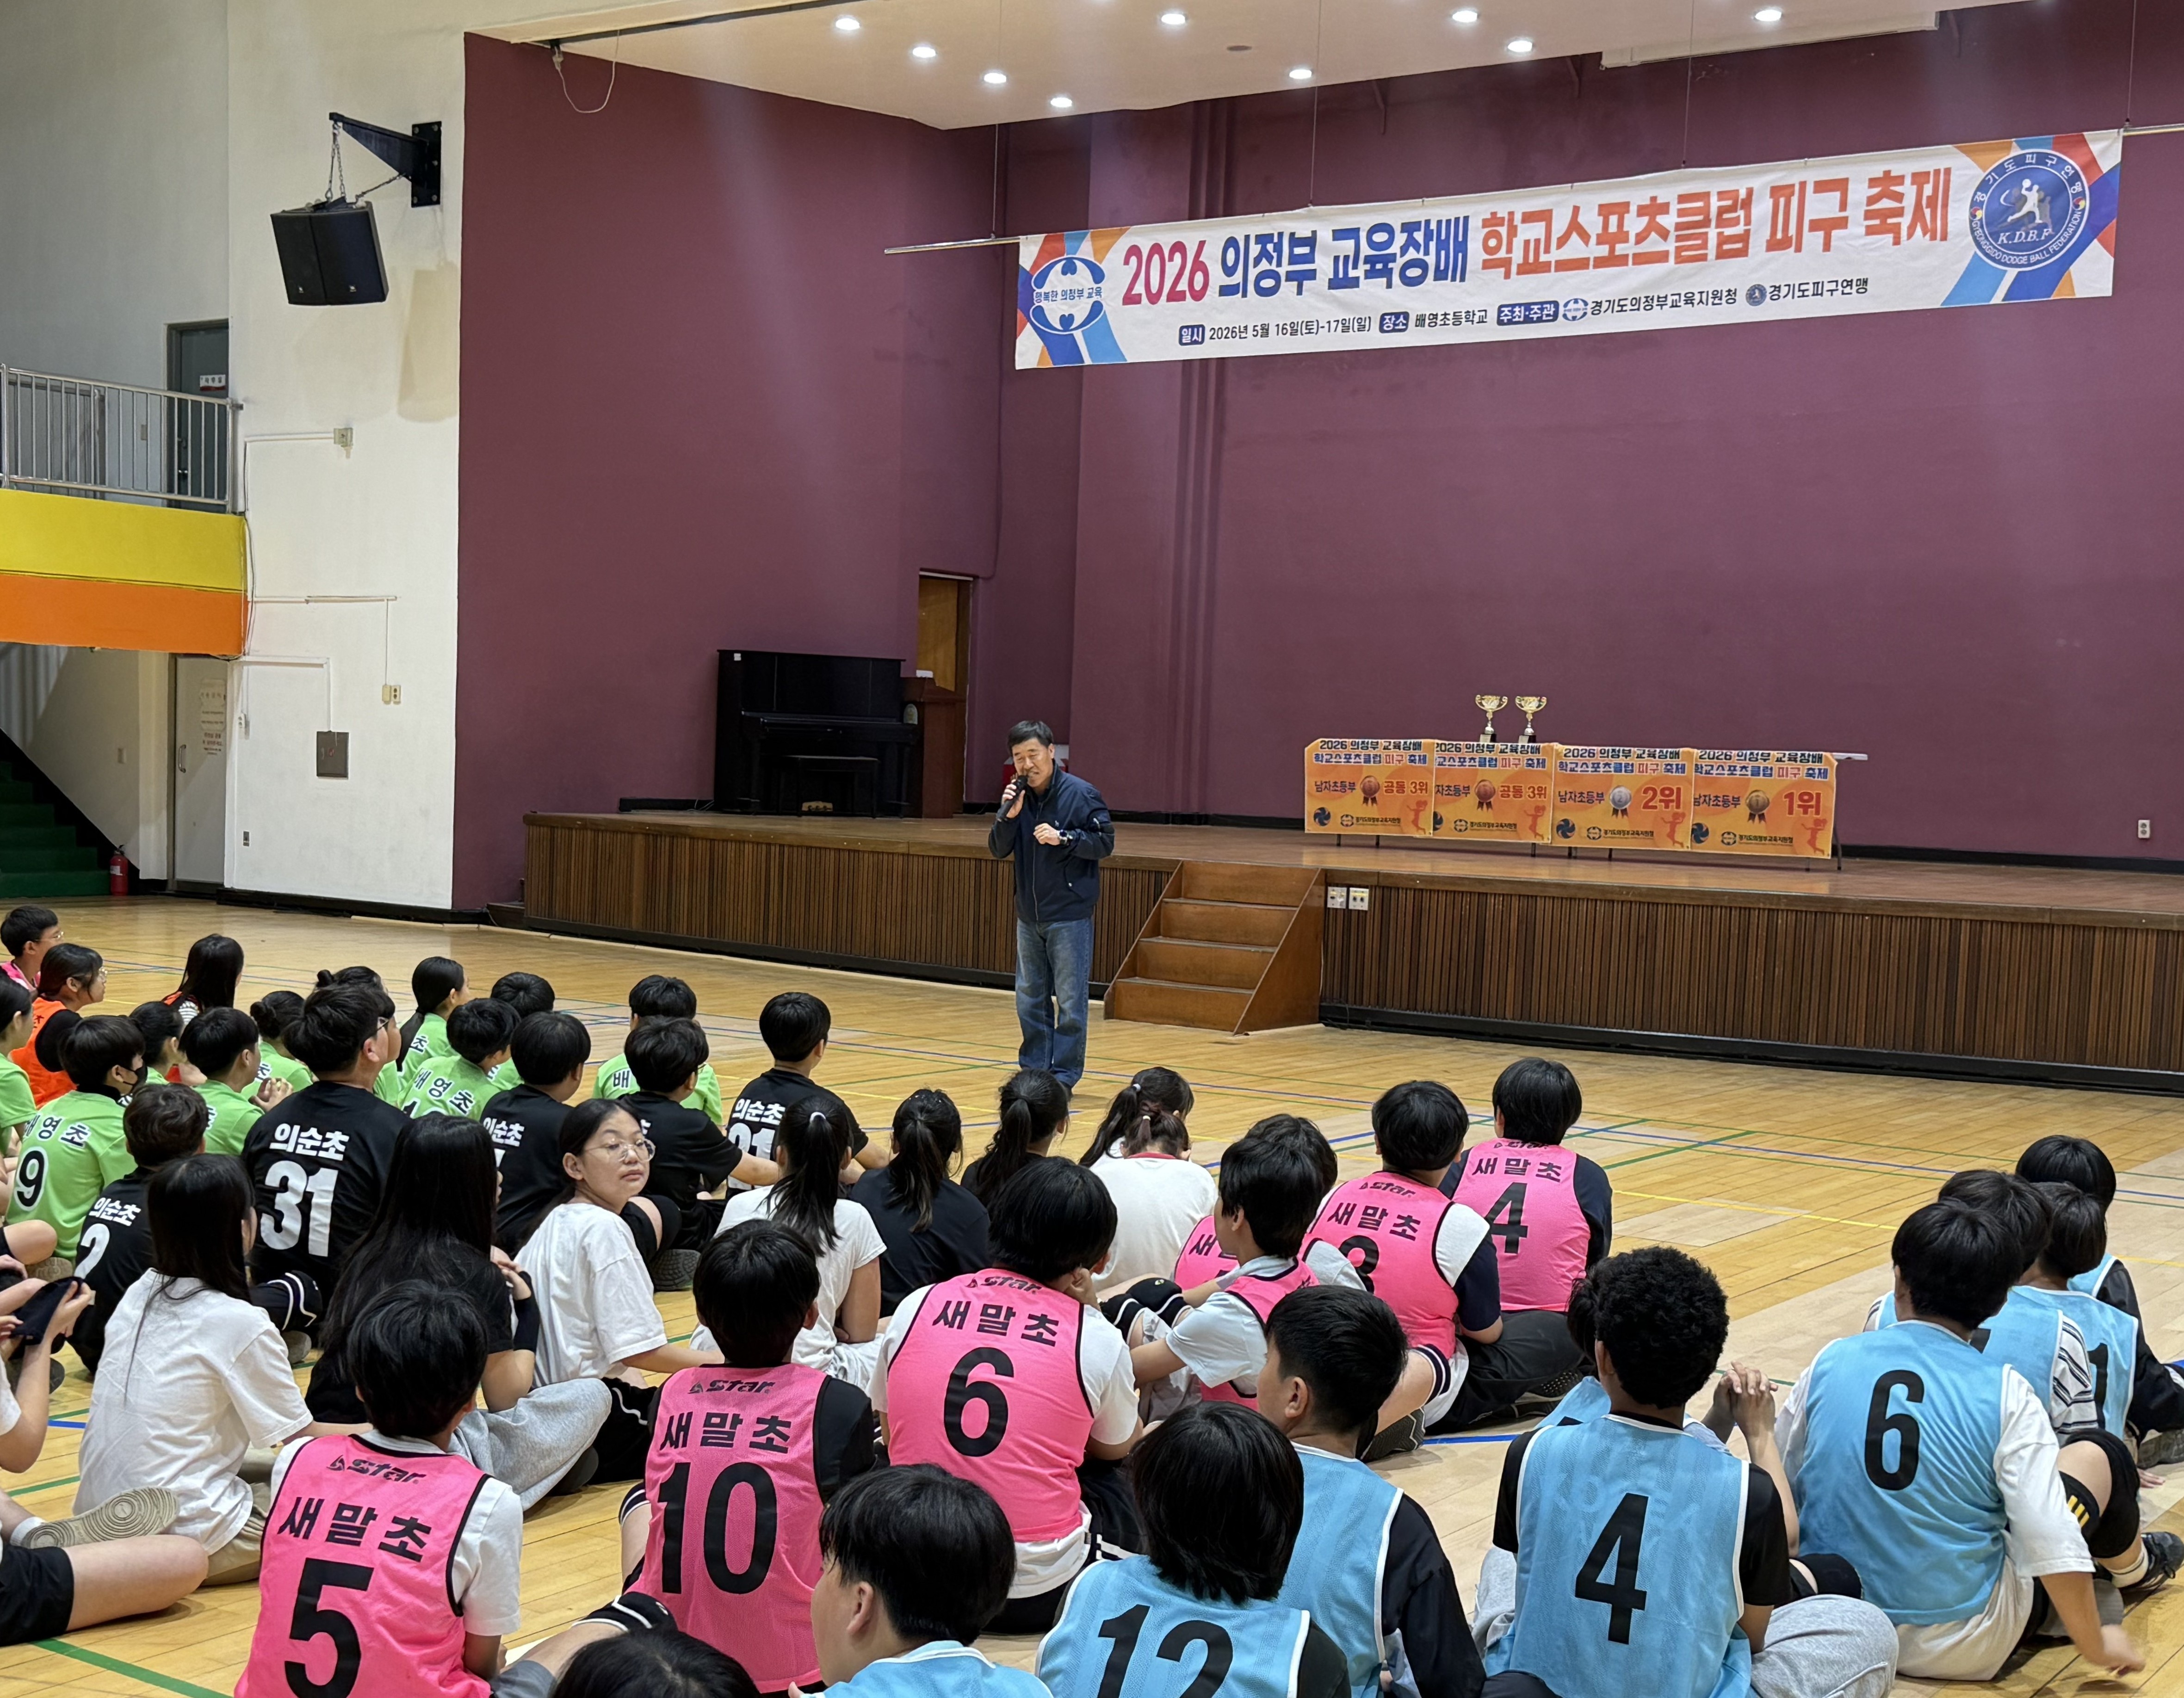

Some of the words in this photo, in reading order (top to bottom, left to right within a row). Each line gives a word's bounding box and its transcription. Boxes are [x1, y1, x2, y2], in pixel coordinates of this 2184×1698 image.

[1122, 240, 1209, 306] 2026
[1219, 231, 1317, 298] 의정부
[1328, 215, 1470, 290] 교육장배
[1481, 186, 1751, 279] 학교스포츠클럽
[1765, 177, 1849, 252] 피구
[1864, 167, 1952, 246] 축제
[1972, 221, 2001, 259] GYEONGGIDO
[2001, 255, 2028, 264] DODGE
[2030, 251, 2049, 262] BALL
[2049, 208, 2082, 253] FEDERATION
[1035, 290, 1058, 303] 행복한
[1061, 288, 1083, 300] 의정부
[1087, 287, 1102, 298] 교육
[1769, 278, 1868, 301] 경기도피구연맹
[1590, 288, 1737, 316] 경기도의정부교육지원청
[1209, 325, 1248, 340] 2026년
[1252, 323, 1269, 337] 5월
[1275, 316, 1371, 336] 16일(토)-17일(일)
[1383, 315, 1407, 330] 장소
[1415, 309, 1487, 327] 배영초등학교
[1182, 327, 1201, 343] 일시
[1320, 741, 1347, 750] 2026
[1350, 741, 1379, 750] 의정부
[1383, 741, 1422, 751] 교육장배
[1465, 743, 1495, 753] 의정부
[1498, 744, 1541, 754] 교육장배
[1564, 748, 1595, 758] 2026
[1599, 748, 1632, 759] 의정부
[1635, 749, 1680, 759] 교육장배
[1699, 750, 1732, 760] 2026
[1736, 751, 1770, 762] 의정부
[1775, 752, 1823, 763] 교육장배
[1314, 753, 1381, 764] 학교스포츠클럽
[1408, 754, 1427, 765] 축제
[1435, 756, 1497, 768] 교스포츠클럽
[1525, 758, 1546, 769] 축제
[1559, 761, 1634, 773] 학교스포츠클럽
[1664, 763, 1685, 774] 축제
[1805, 767, 1828, 779] 축제
[1315, 781, 1356, 793] 남자초등부
[1384, 780, 1406, 794] 공동
[1410, 781, 1428, 794] 3위
[1500, 784, 1523, 799] 공동
[1528, 785, 1547, 799] 3위
[1559, 790, 1604, 804] 남자초등부
[1642, 786, 1681, 809] 2위
[1784, 791, 1821, 815] 1위
[732, 1099, 786, 1125] 의순초
[269, 1124, 349, 1161] 의순초
[17, 1150, 44, 1206] 9
[89, 1197, 141, 1226] 의순초
[260, 1160, 338, 1257] 31
[1483, 1182, 1528, 1254] 4
[74, 1223, 110, 1279] 2
[944, 1347, 1014, 1457] 6
[1864, 1370, 1924, 1490] 6
[347, 1459, 427, 1482] star
[657, 1462, 777, 1594] 10
[1575, 1493, 1649, 1645] 4
[284, 1557, 374, 1698] 5
[1097, 1604, 1233, 1698] 12
